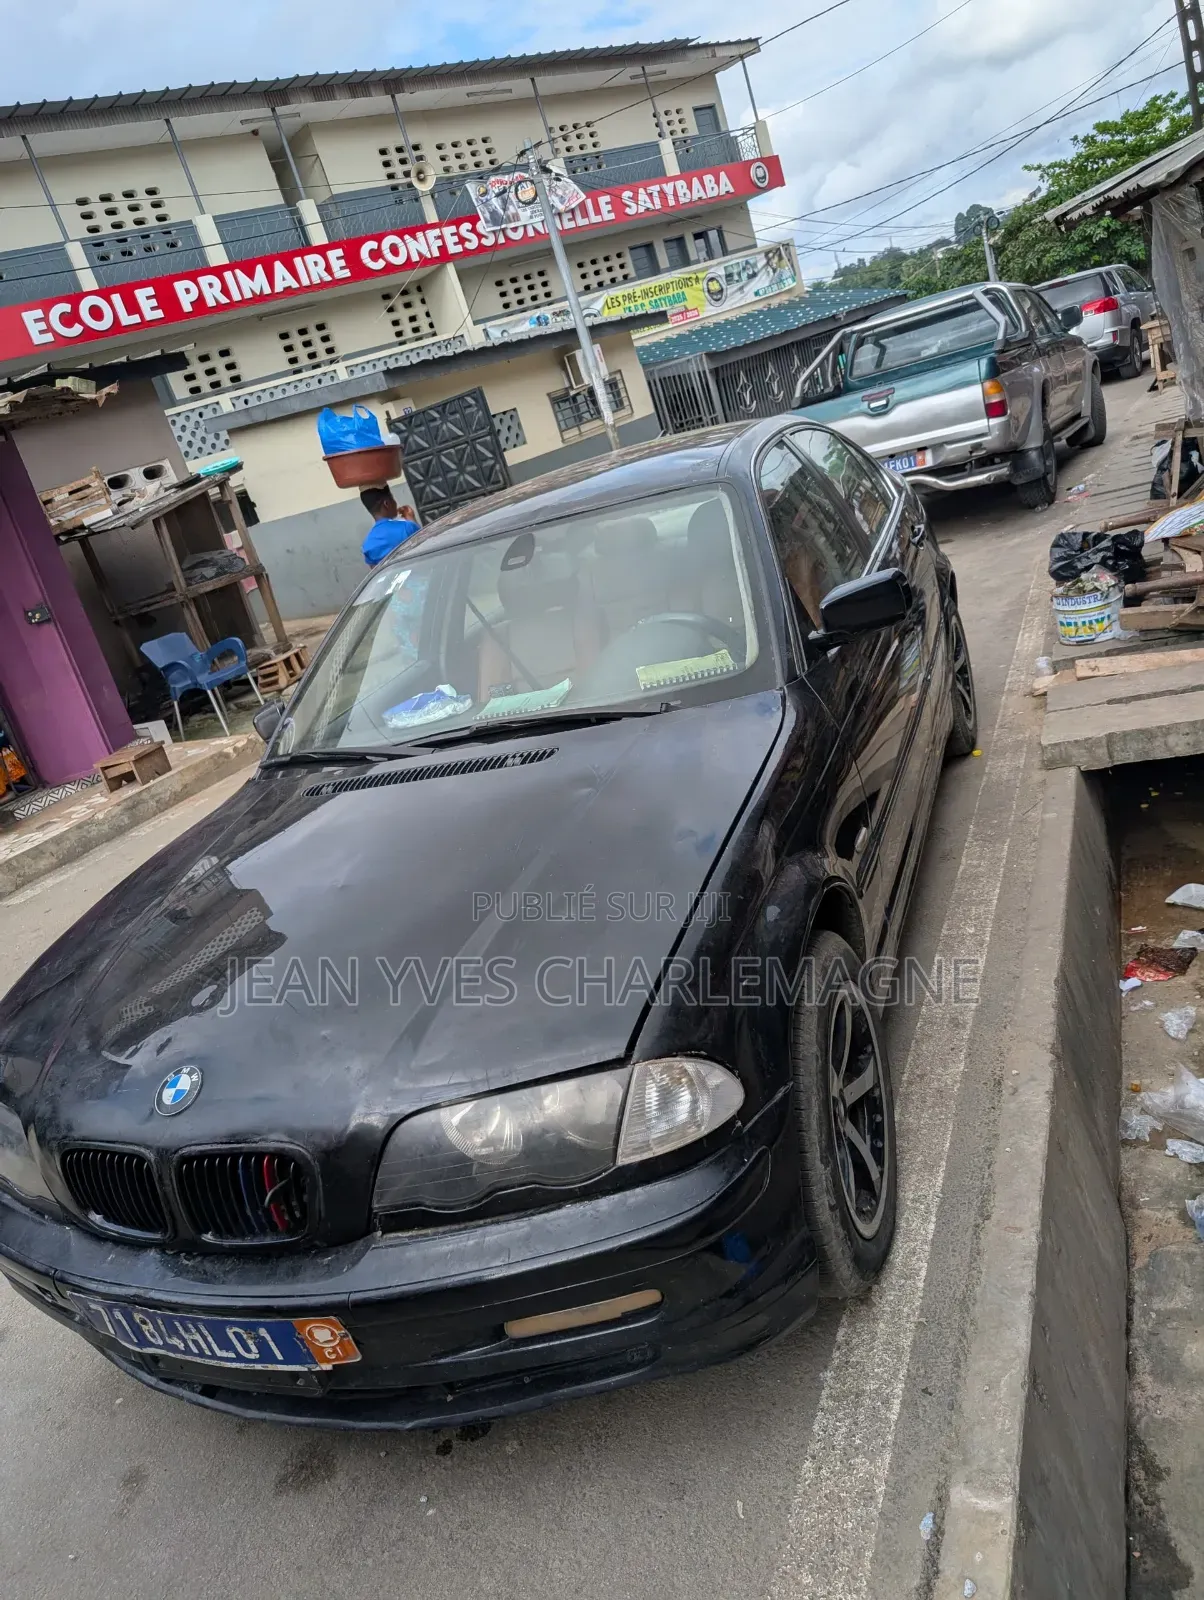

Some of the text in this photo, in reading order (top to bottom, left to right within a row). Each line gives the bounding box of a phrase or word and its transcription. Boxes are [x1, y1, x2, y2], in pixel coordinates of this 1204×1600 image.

[21, 287, 164, 345] ECOLE
[173, 248, 351, 312] PRIMAIRE
[621, 171, 735, 216] SATYBABA
[606, 296, 621, 310] LES
[622, 276, 694, 305] PRÉ-INSCRIPTIONS
[648, 291, 688, 310] SATYBABA
